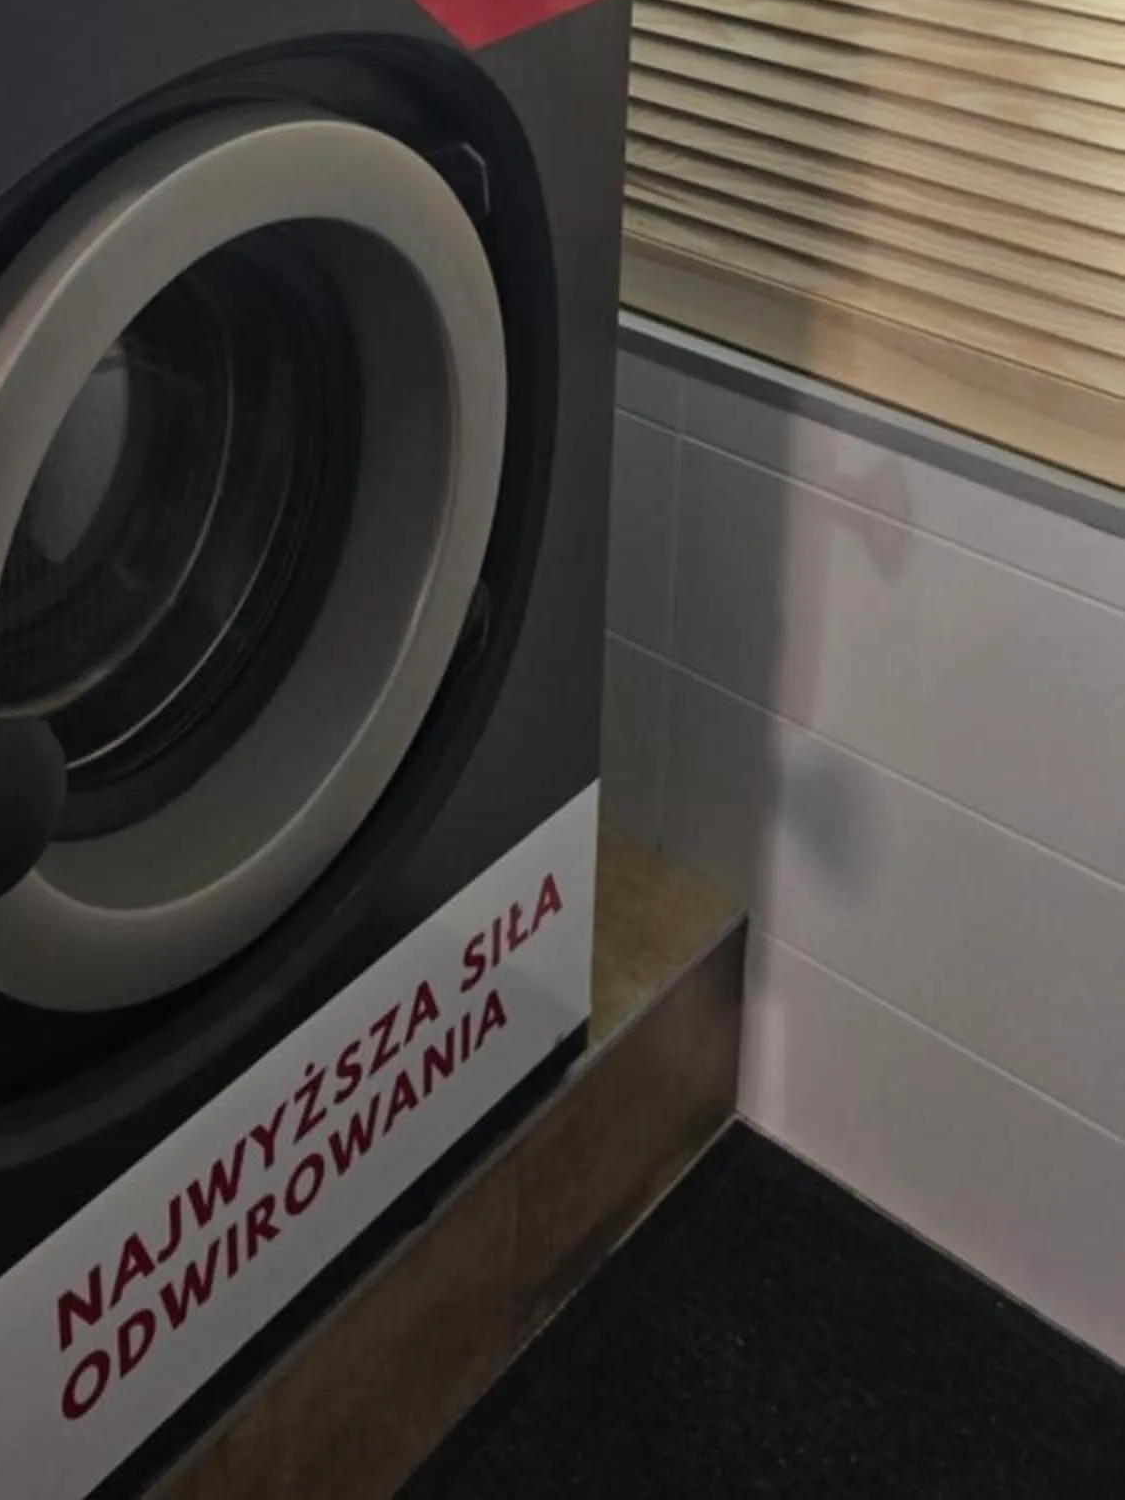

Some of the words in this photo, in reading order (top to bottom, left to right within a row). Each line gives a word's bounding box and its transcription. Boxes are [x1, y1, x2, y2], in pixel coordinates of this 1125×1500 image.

[56, 979, 440, 1352] NAJWYŻSZA
[460, 872, 564, 993] SIŁA
[60, 988, 508, 1421] ODWIROWANIA
